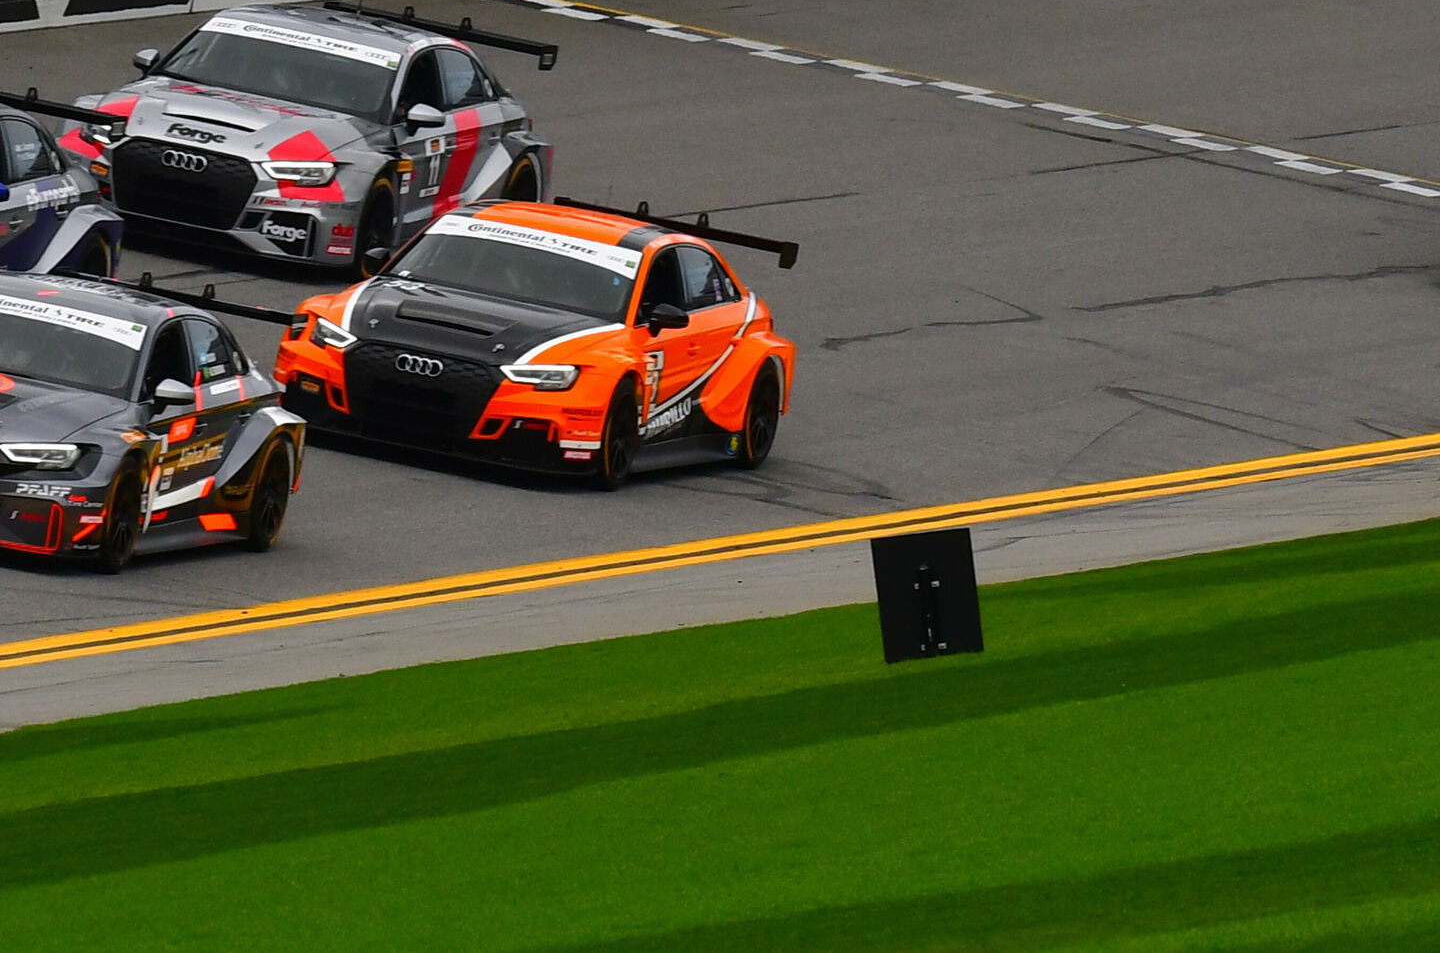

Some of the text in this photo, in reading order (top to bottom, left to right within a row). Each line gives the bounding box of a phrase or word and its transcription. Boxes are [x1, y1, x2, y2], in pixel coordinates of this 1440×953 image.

[242, 24, 311, 42] Continental
[166, 123, 227, 144] Forge
[262, 220, 308, 243] Forge
[467, 223, 598, 256] Continental TIRE
[66, 313, 107, 329] TIRE
[15, 483, 72, 497] PFAFF
